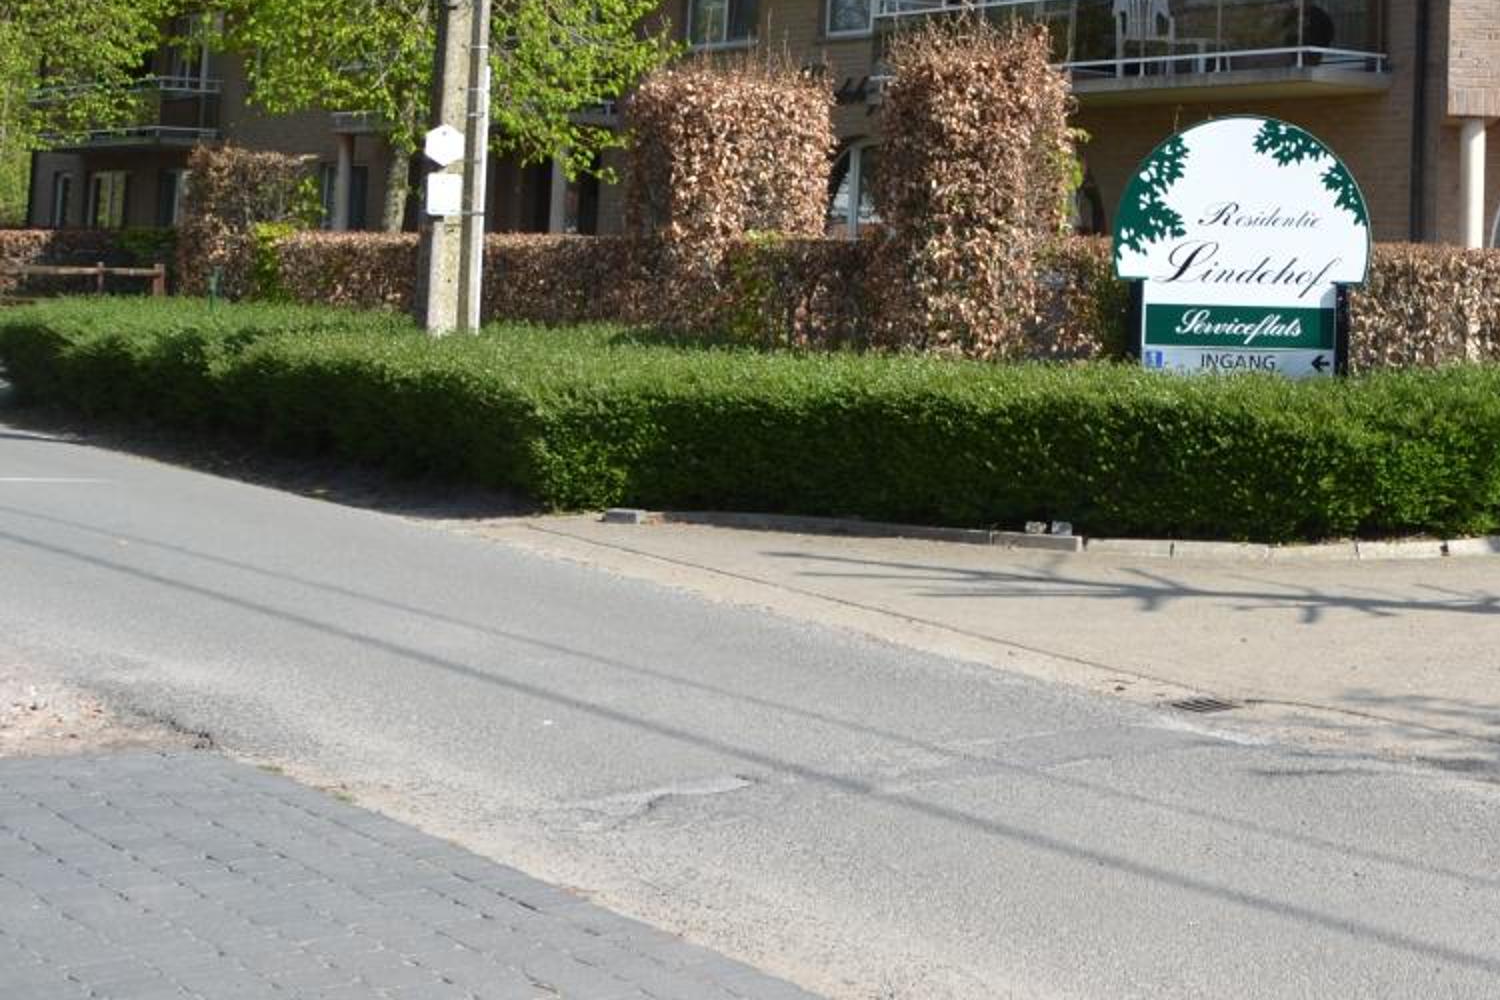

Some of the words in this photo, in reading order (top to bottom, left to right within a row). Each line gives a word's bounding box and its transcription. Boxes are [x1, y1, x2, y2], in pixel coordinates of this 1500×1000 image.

[1198, 201, 1321, 229] Residentie
[1152, 240, 1342, 298] Lindehof
[1175, 309, 1302, 345] Serviceflats
[1200, 353, 1275, 371] INGANG
